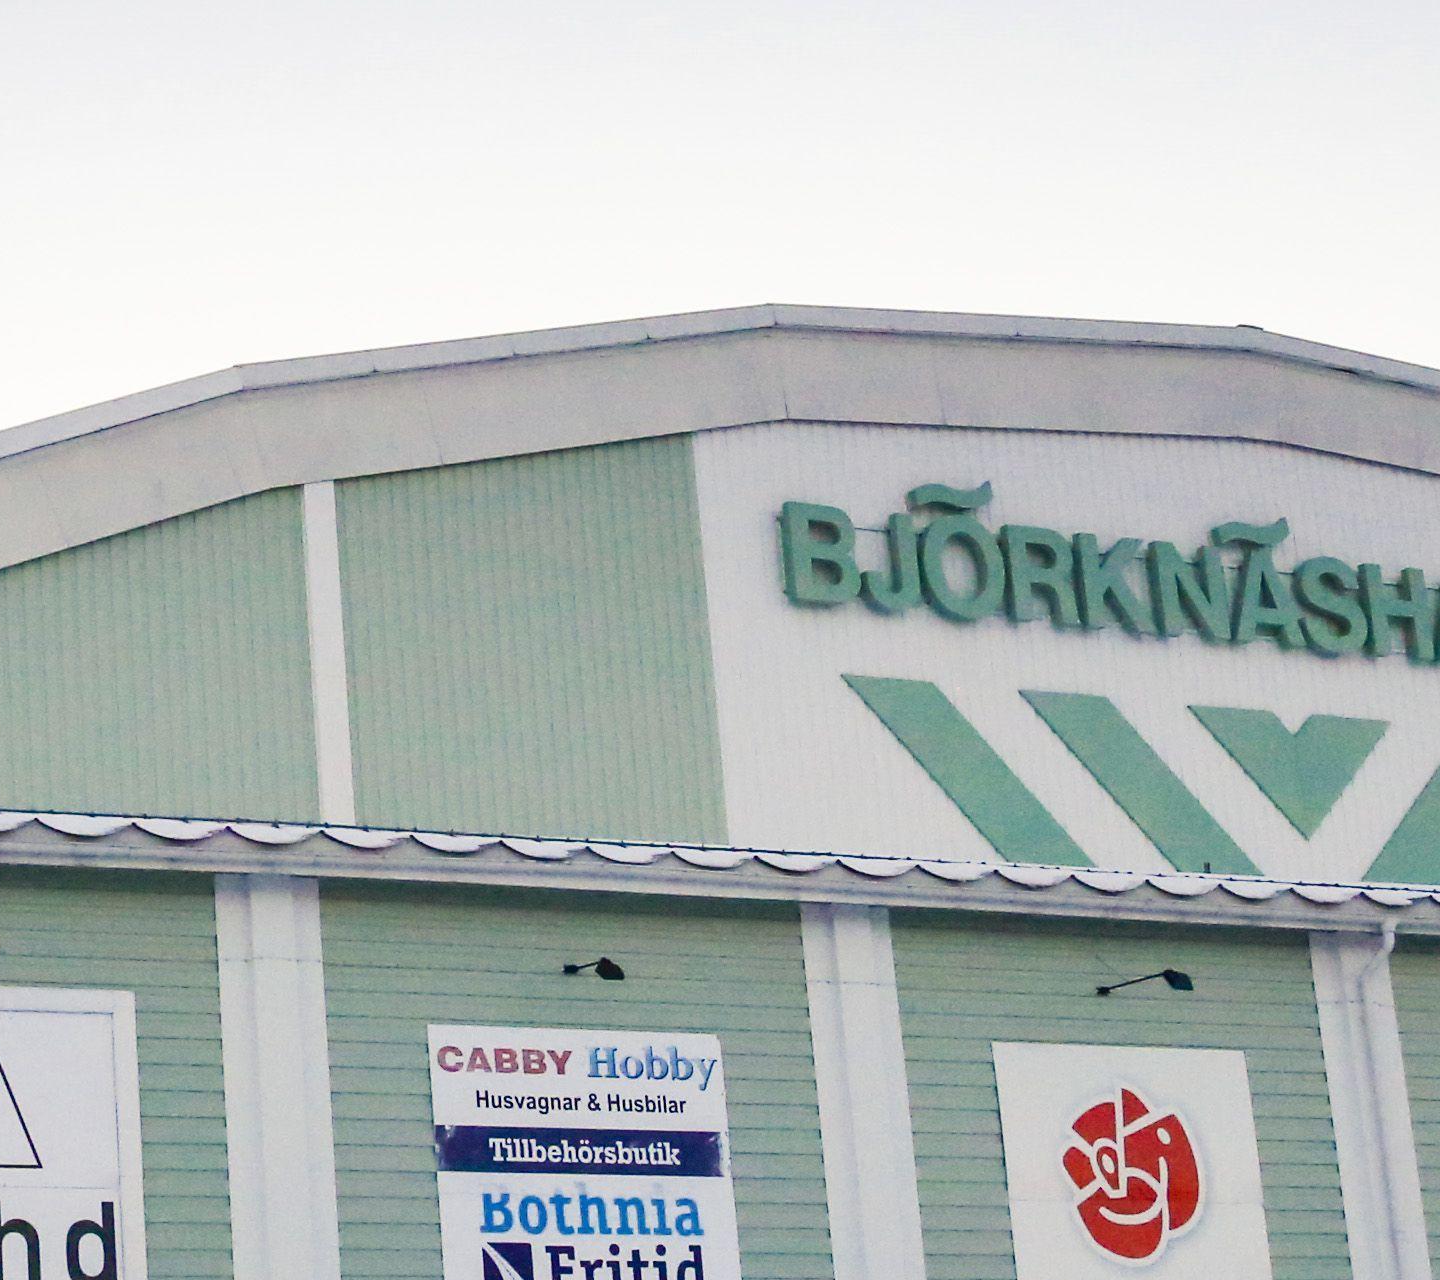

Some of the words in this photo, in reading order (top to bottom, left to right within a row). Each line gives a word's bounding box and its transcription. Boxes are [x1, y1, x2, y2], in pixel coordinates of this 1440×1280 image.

[437, 1045, 572, 1075] CABBY
[587, 1046, 718, 1091] Hobby
[476, 1090, 581, 1115] Husvagnar
[588, 1094, 601, 1112] &
[607, 1094, 686, 1114] Husbilar
[488, 1137, 681, 1166] Tillbehörsbutik
[480, 1186, 704, 1236] Bothnia
